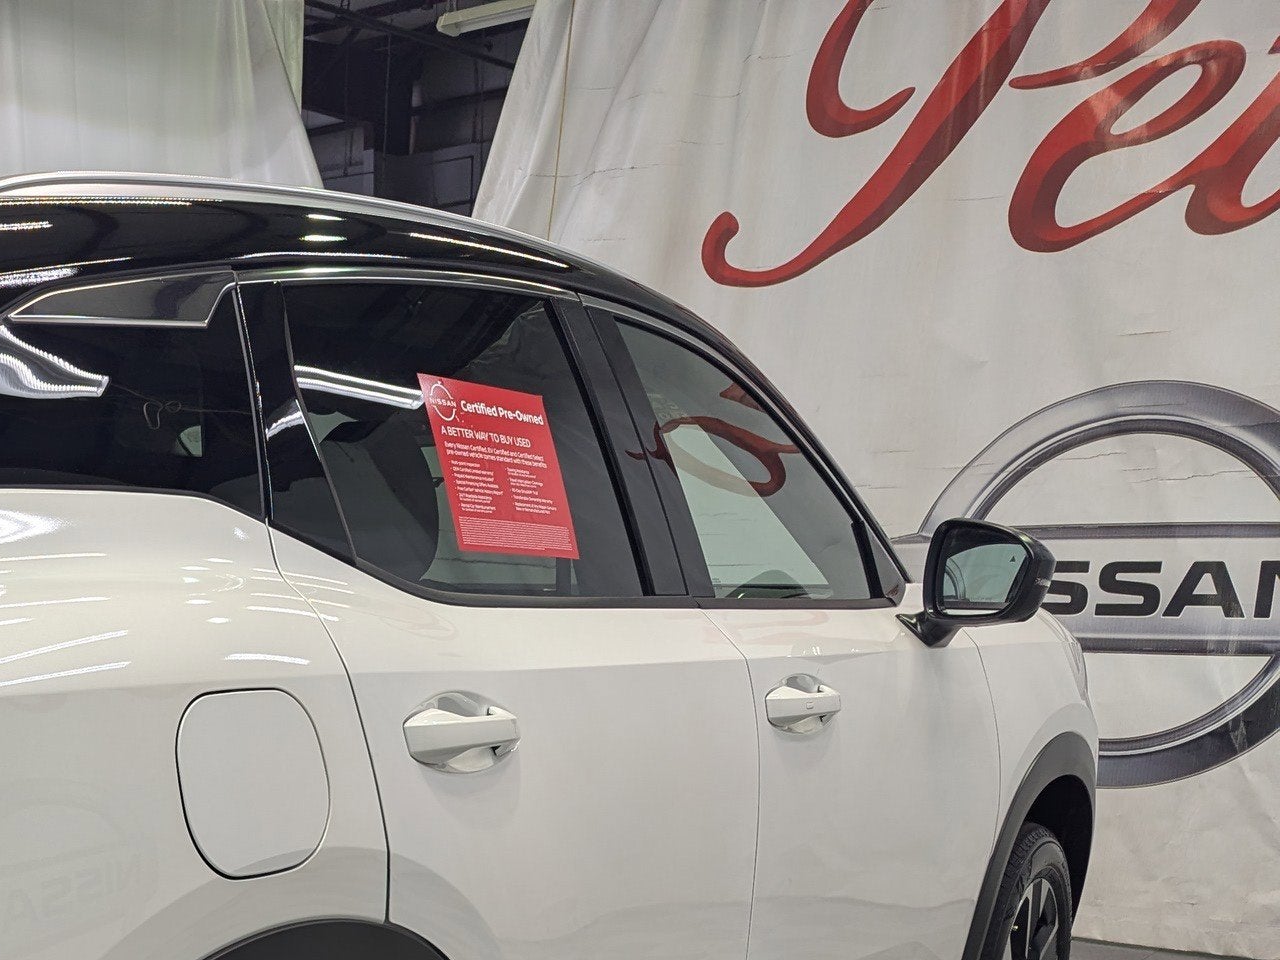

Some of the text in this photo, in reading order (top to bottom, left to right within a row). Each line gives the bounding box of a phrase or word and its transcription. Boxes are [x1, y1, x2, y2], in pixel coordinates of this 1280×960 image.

[429, 397, 457, 408] NISSAN
[460, 400, 544, 425] Certified Pre-Owned
[441, 425, 531, 448] A BETTER WAY TO BUY USED
